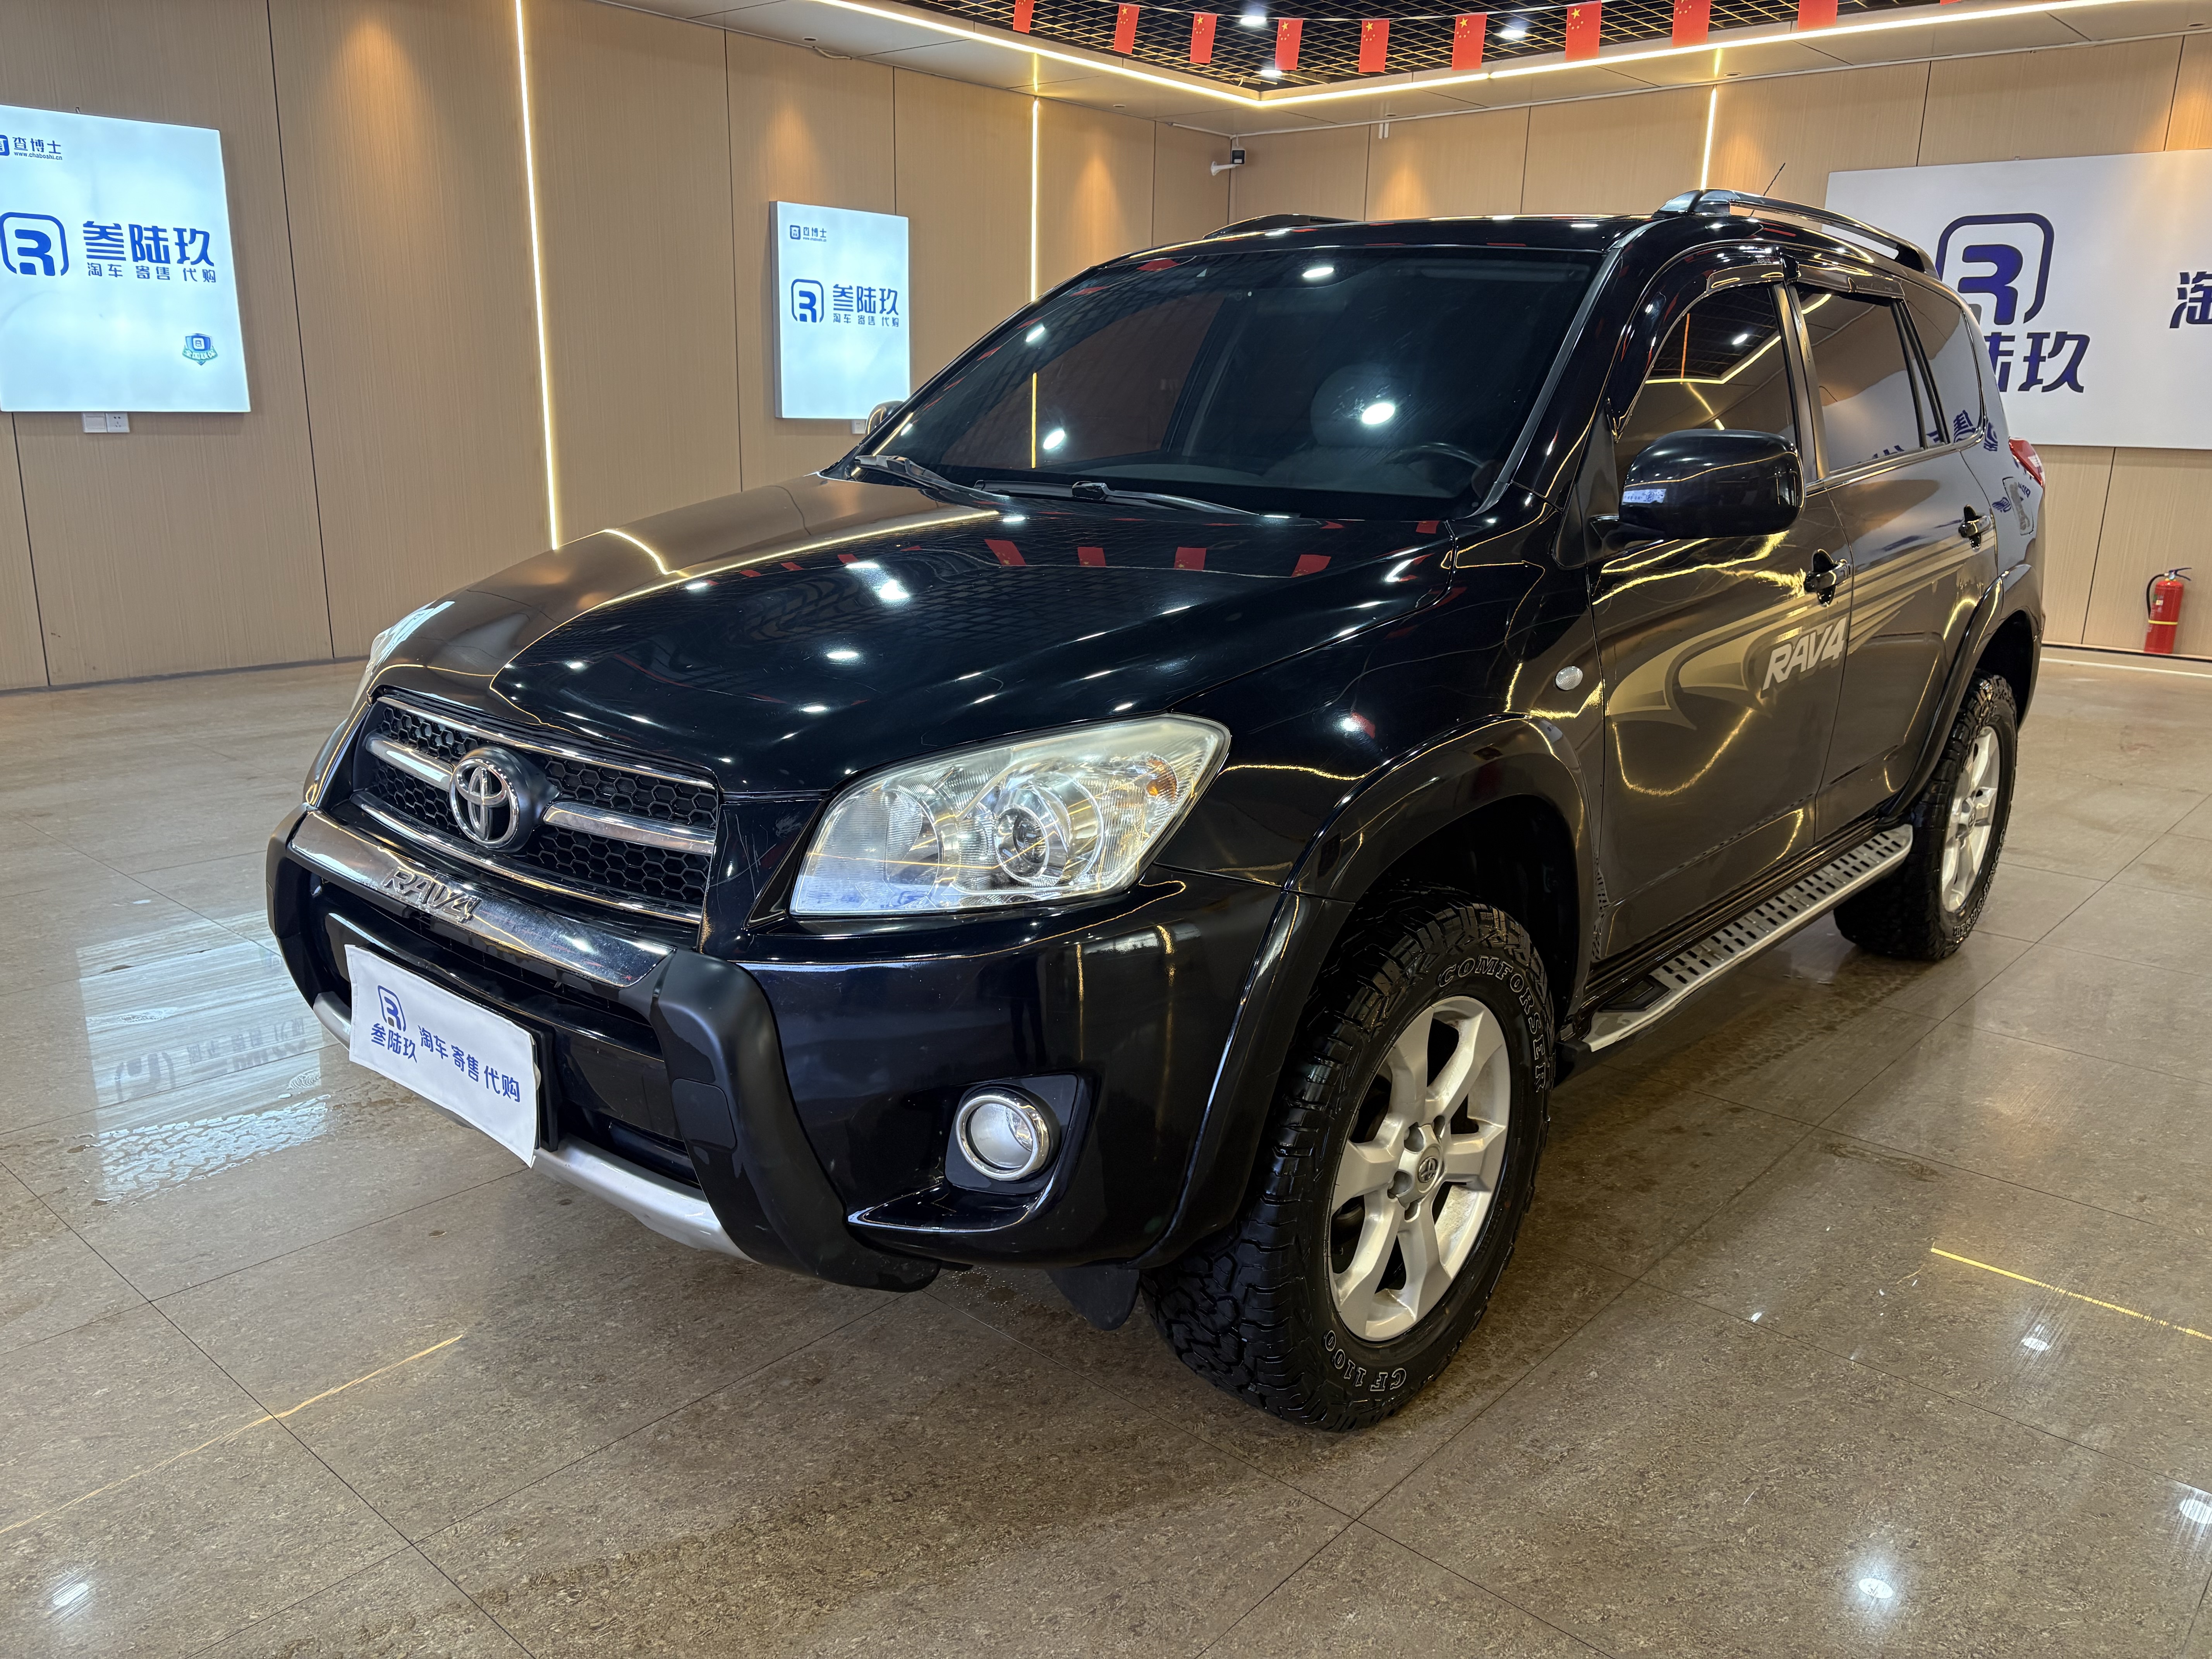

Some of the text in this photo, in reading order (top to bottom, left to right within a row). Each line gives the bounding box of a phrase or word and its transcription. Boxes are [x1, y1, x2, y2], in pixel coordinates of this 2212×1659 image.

[14, 151, 62, 160] www.chaboshi.cn
[83, 221, 214, 266] 叁陆玖
[87, 262, 216, 283] 淘车 寄售 代购
[833, 284, 899, 315] 叁陆玖
[1762, 617, 1846, 691] RAV4
[381, 866, 482, 924] RAV4
[371, 1023, 417, 1063] 叁陆玖
[1439, 955, 1547, 1093] COMFORSER
[417, 1025, 520, 1103] 淘车 寄售 代购
[1325, 1330, 1407, 1391] CF 1100
